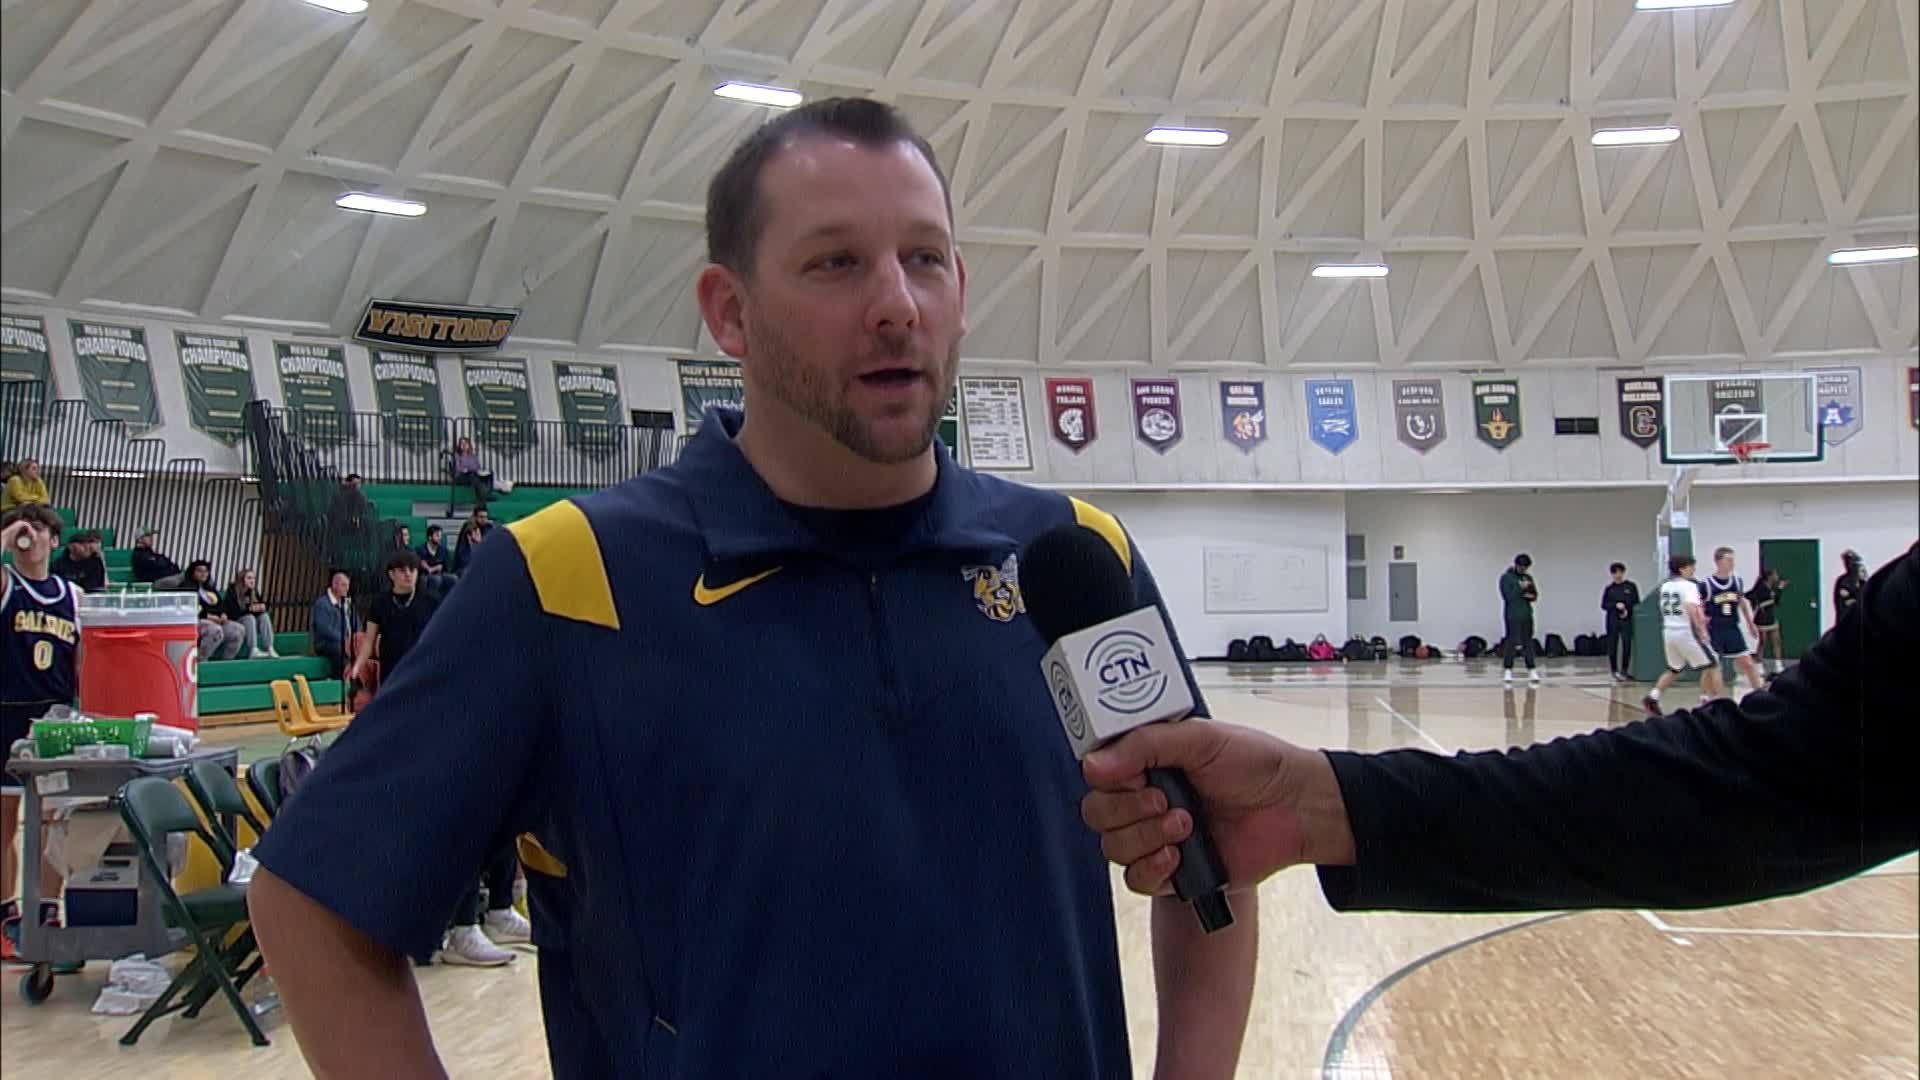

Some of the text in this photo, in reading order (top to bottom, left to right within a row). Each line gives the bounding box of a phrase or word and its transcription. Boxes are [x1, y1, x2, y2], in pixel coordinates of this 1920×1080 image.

[368, 309, 512, 341] VISITORS
[76, 337, 146, 361] CHAMPIONS
[182, 347, 248, 371] CHAMPIONS
[281, 357, 345, 378] CHAMPIONS
[375, 363, 436, 384] CHAMPIONS
[467, 369, 526, 389] CHAMPIONS
[559, 375, 617, 396] CHAMPIONS
[1056, 396, 1086, 404] TROJANS
[1663, 592, 1682, 616] 22
[14, 610, 76, 645] SALINE
[34, 640, 53, 670] 0
[1099, 651, 1151, 684] CTN
